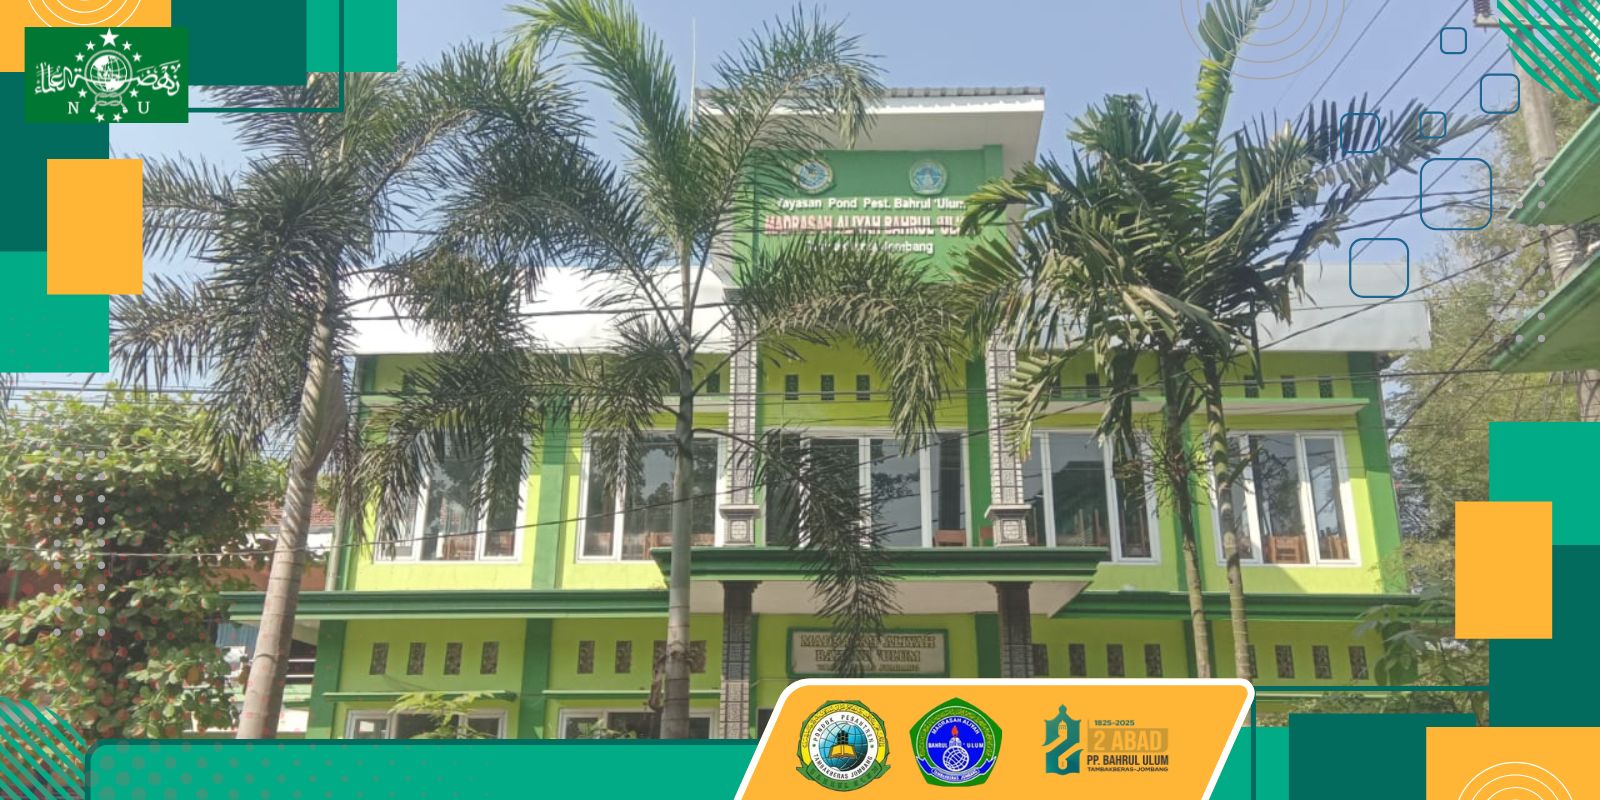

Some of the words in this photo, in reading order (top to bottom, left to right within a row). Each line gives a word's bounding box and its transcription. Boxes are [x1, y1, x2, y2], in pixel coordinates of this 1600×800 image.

[828, 197, 858, 208] Pond
[894, 198, 931, 209] Bahrul
[764, 215, 833, 234] MADRASAH
[837, 215, 881, 234] ALIYAH
[884, 215, 935, 235] BAHRUL
